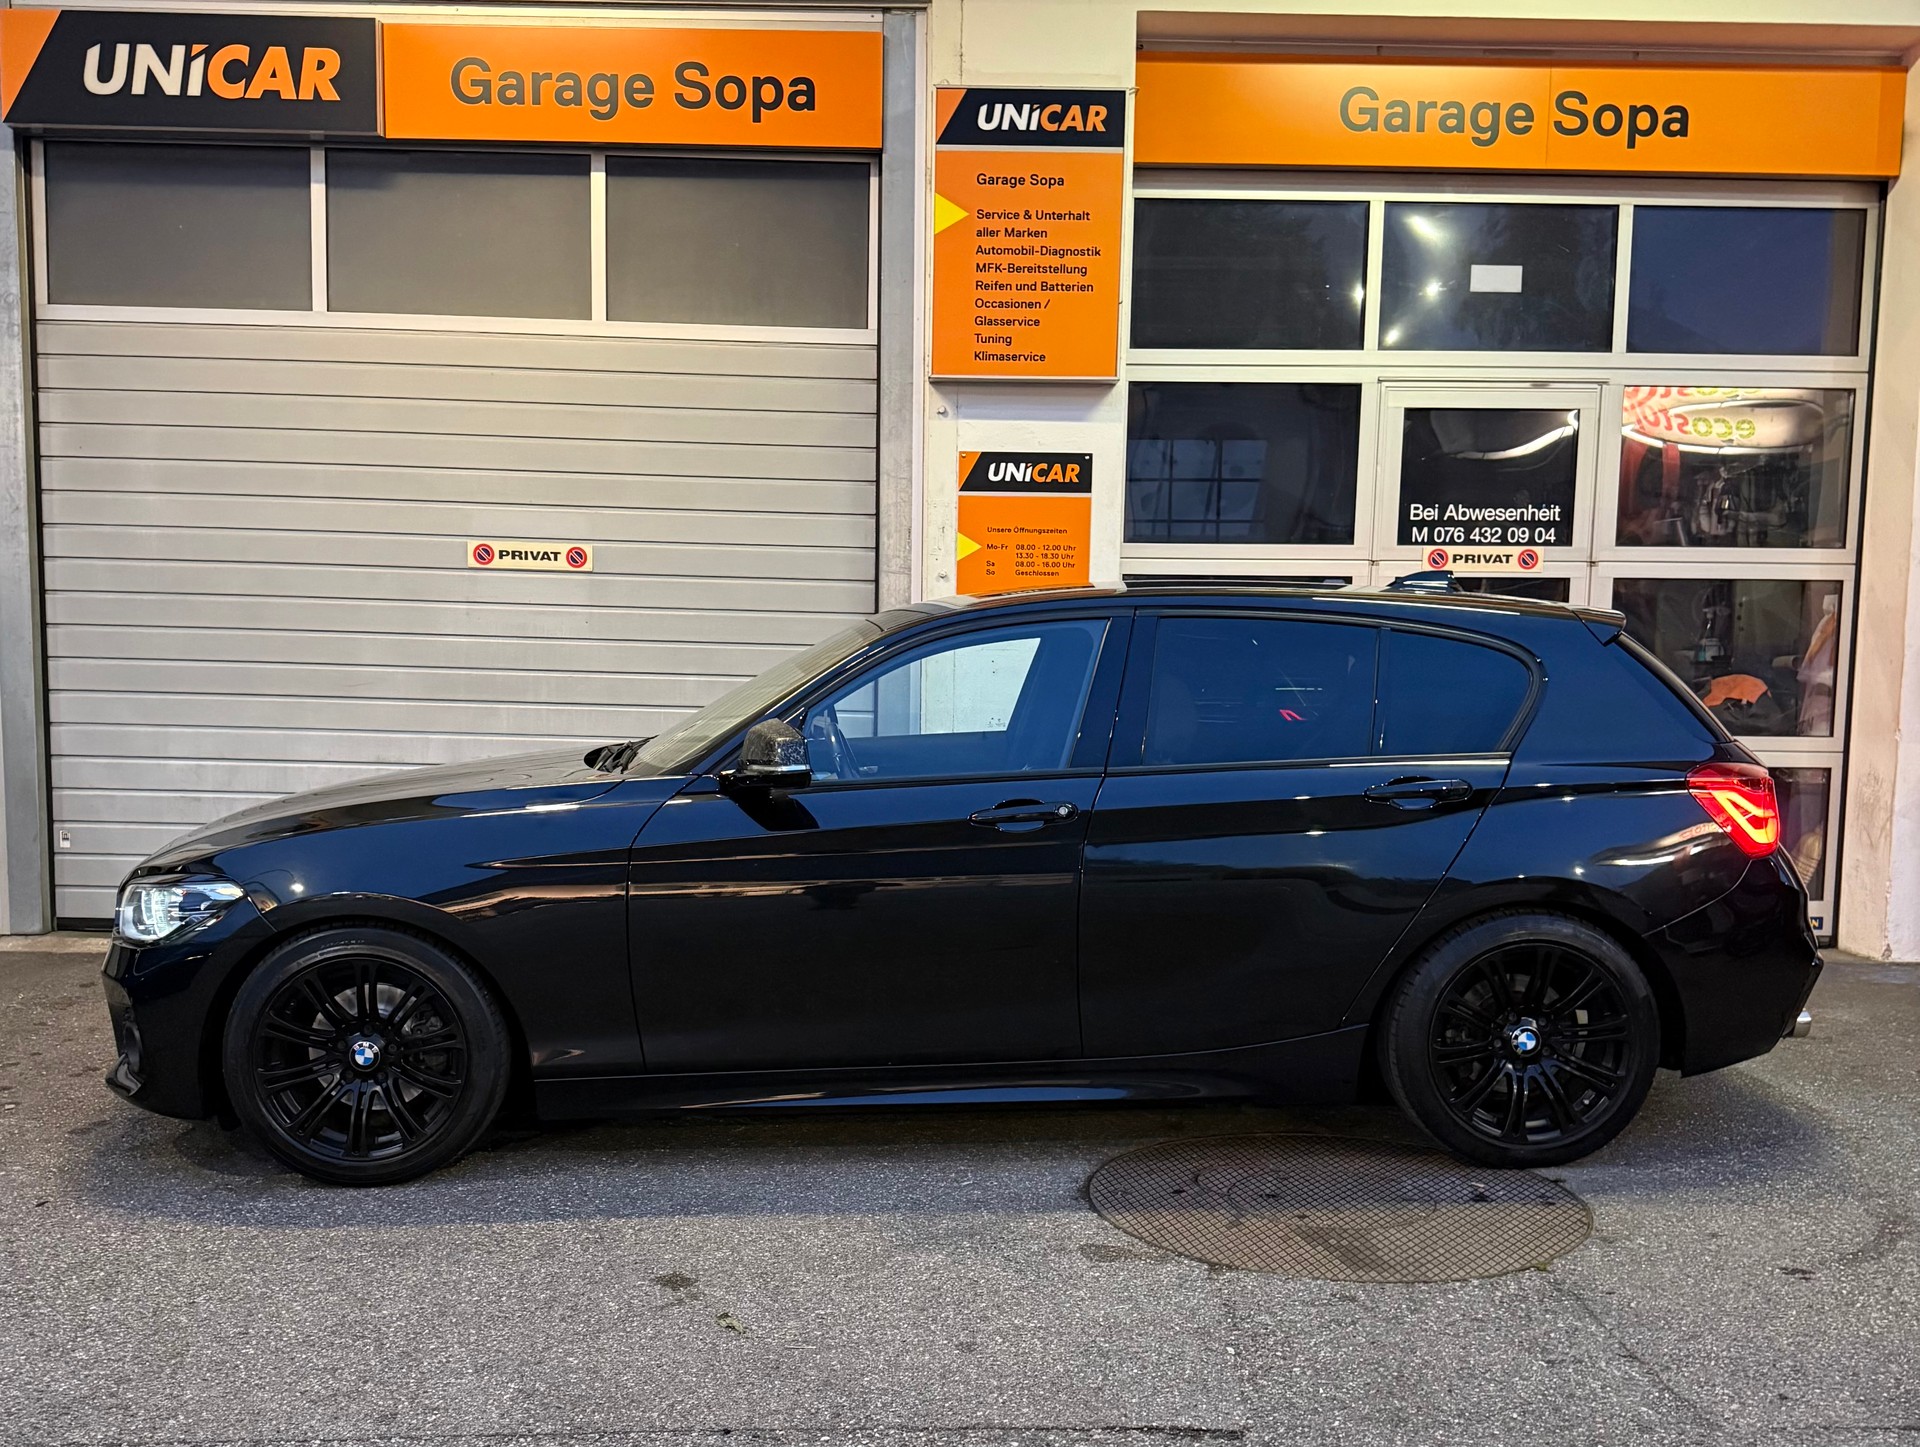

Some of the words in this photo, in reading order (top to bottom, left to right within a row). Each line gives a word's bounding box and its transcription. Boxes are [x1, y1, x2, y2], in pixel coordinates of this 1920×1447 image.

[450, 57, 655, 121] Garage
[674, 61, 816, 123] Sopa
[1340, 86, 1535, 148] Garage
[1553, 90, 1689, 149] Sopa
[976, 173, 1025, 189] Garage
[1030, 174, 1065, 189] Sopa
[977, 209, 1020, 221] Service
[1023, 210, 1032, 221] &
[1036, 210, 1090, 221] Unterhalt
[976, 227, 1001, 238] aller
[1004, 228, 1048, 238] Marken
[976, 245, 1101, 258] Automobil-Diagnostik
[976, 264, 1087, 277] MFK-Bereitstellung
[975, 281, 1012, 292] Reifen
[1016, 282, 1037, 292] und
[1040, 282, 1094, 292] Batterien
[975, 299, 1042, 310] Occasionen
[1044, 299, 1051, 310] /
[974, 316, 1041, 327] Glasservice
[974, 334, 1013, 346] Tuning
[974, 351, 1046, 362] Klimaservice
[1410, 504, 1439, 521] Bei
[1444, 504, 1561, 522] Abwesenheit
[1412, 527, 1428, 543] M
[1434, 527, 1465, 543] 076
[1470, 527, 1502, 543] 432
[1507, 527, 1530, 543] 09
[1534, 528, 1557, 543] 04
[499, 550, 561, 561] PRIVAT
[1452, 554, 1513, 564] PRIVAT
